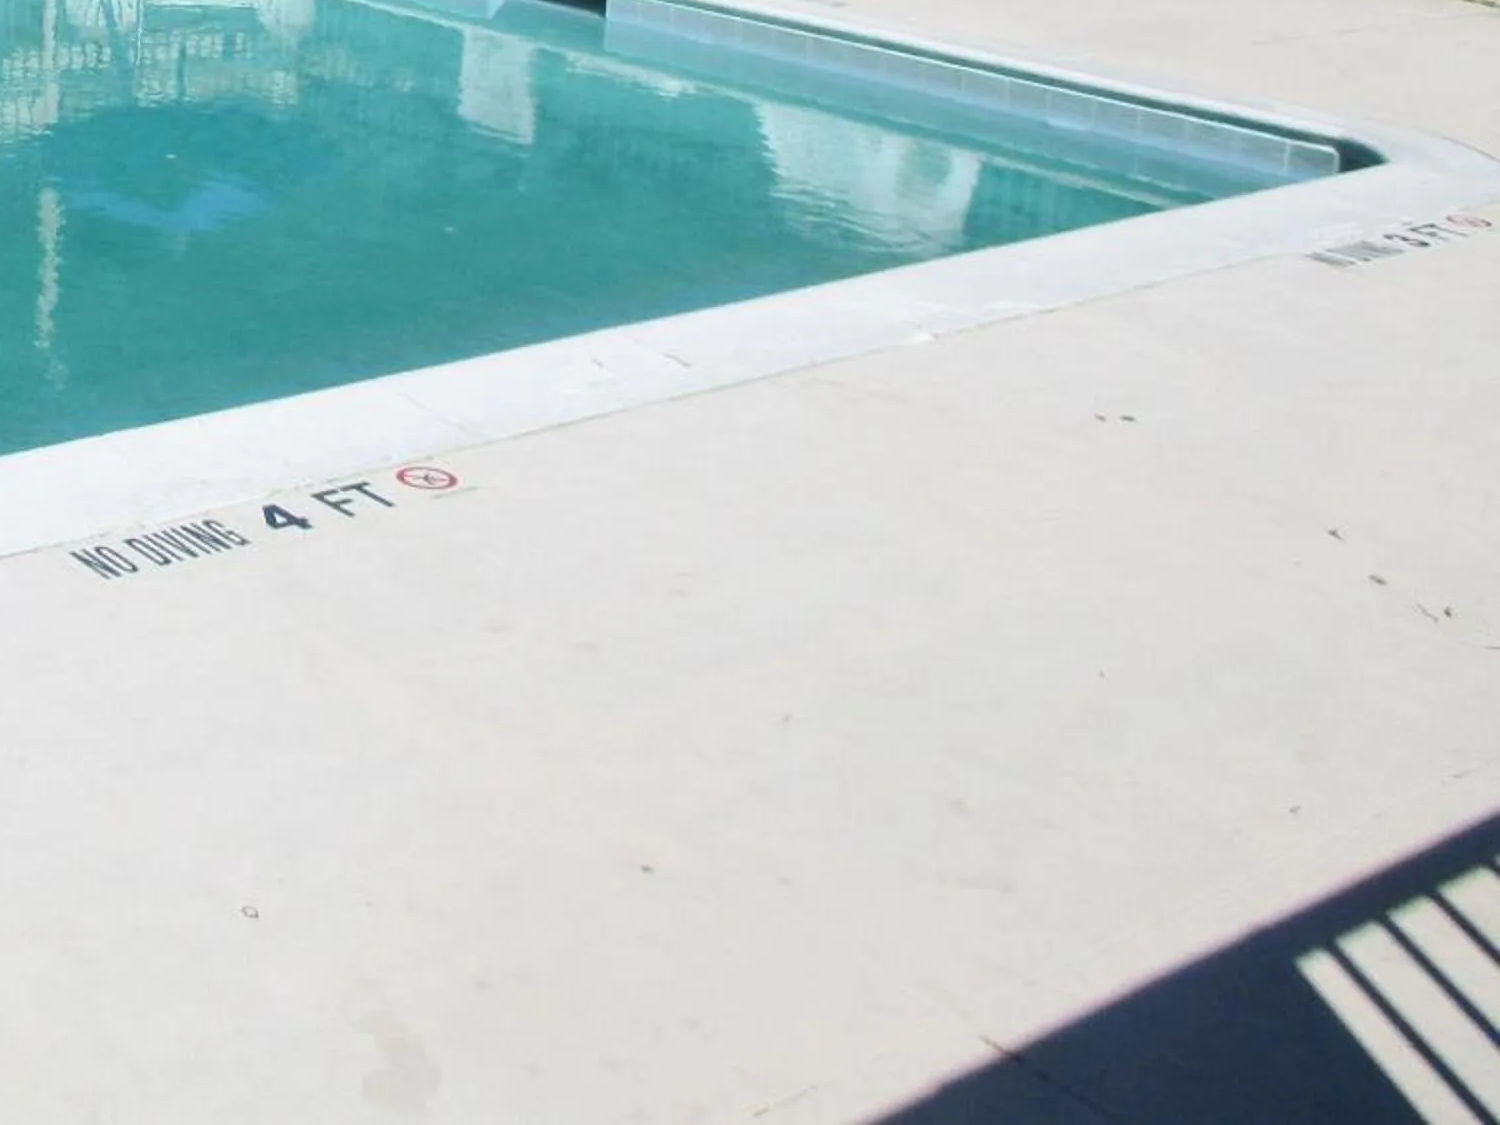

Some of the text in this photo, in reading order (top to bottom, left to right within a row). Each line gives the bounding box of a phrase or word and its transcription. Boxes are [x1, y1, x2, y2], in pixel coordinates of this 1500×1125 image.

[69, 481, 396, 580] NO DIVING 4 FT
